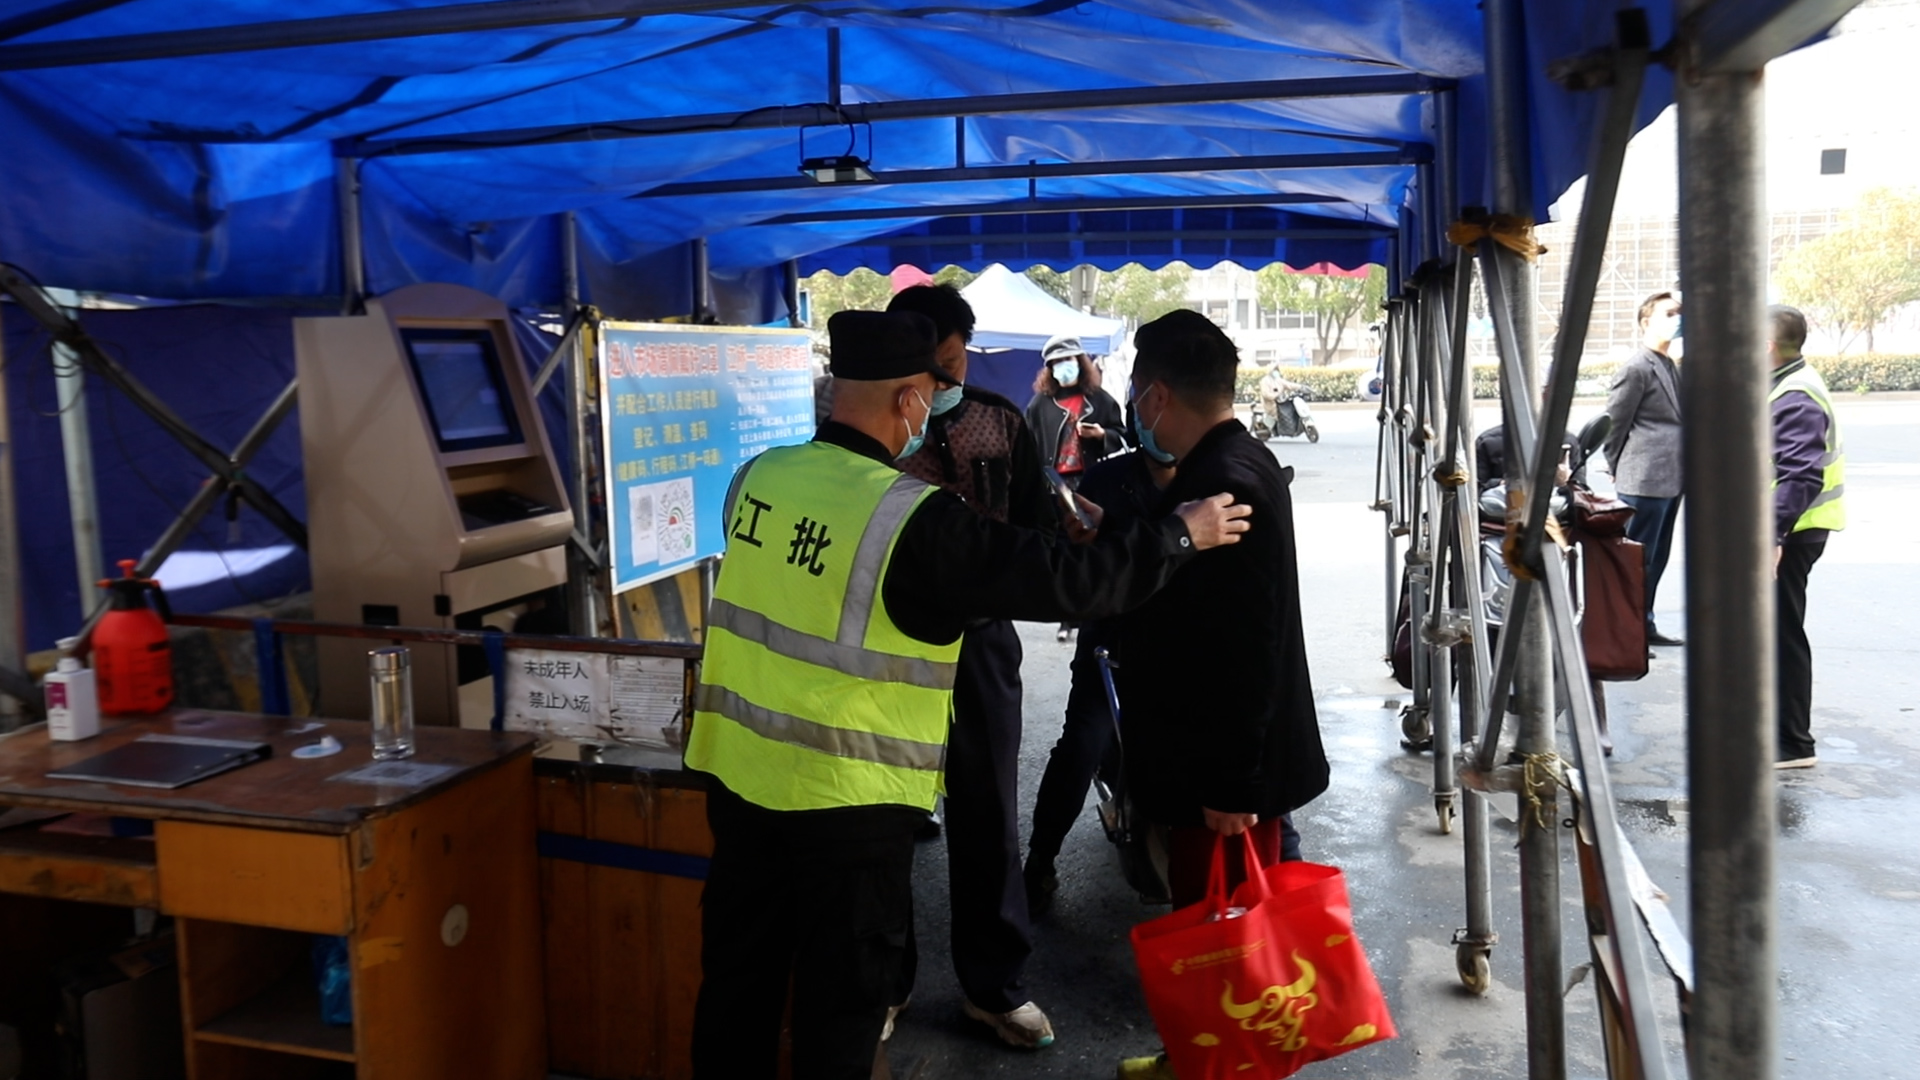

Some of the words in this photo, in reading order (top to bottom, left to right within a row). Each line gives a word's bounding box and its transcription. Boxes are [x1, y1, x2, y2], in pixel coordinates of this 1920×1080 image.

[731, 492, 832, 577] 江批
[523, 660, 589, 680] 未成年人
[528, 691, 591, 713] 禁止入场
